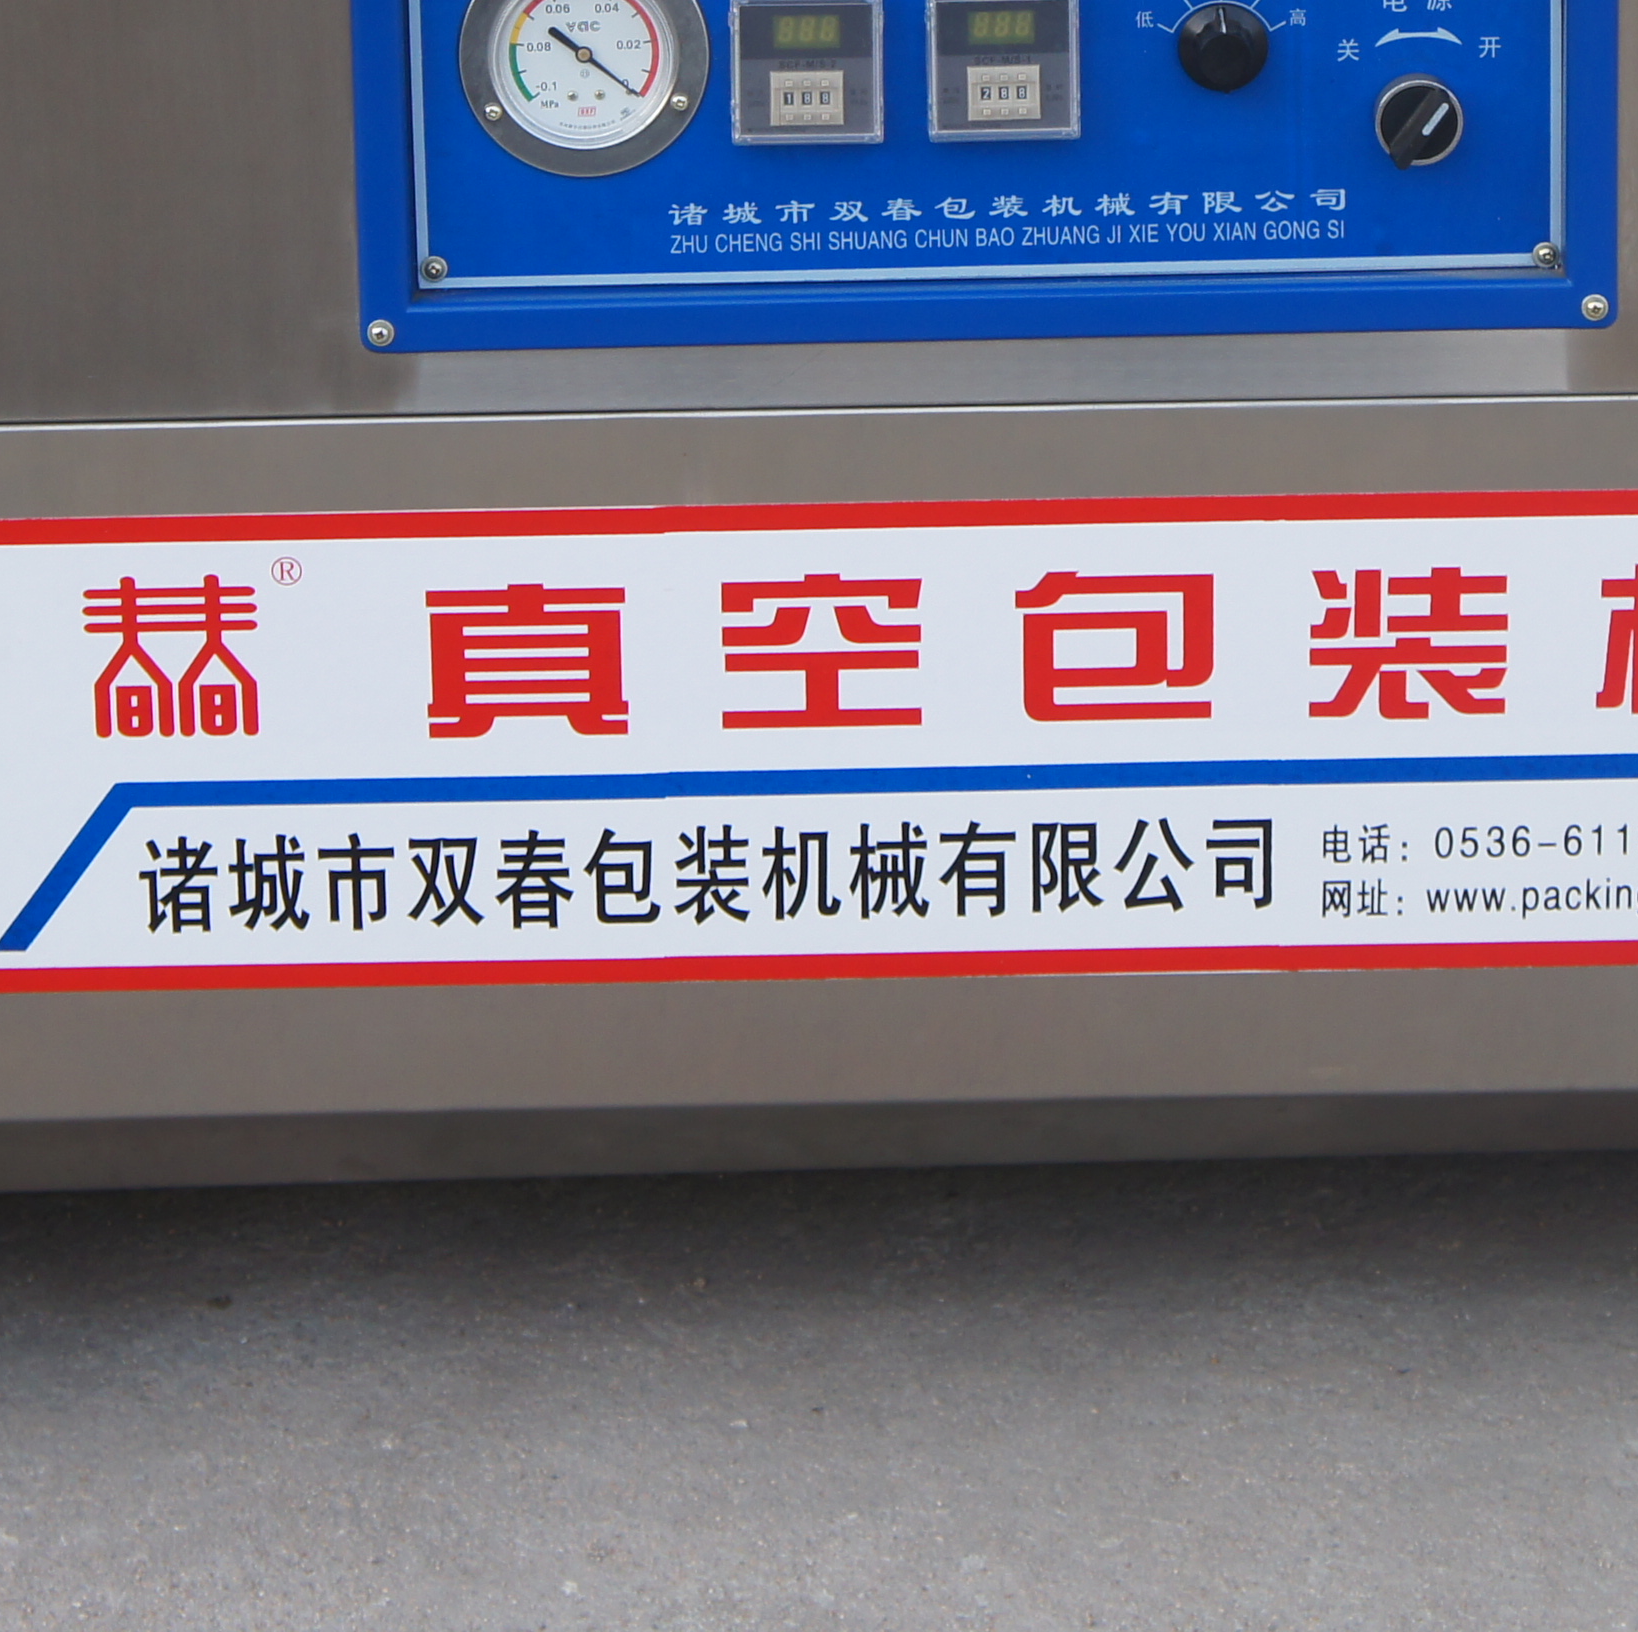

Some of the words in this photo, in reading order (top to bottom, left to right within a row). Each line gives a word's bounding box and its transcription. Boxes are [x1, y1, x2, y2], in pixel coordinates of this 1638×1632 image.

[545, 3, 571, 14] 0.06
[594, 3, 620, 14] 0.04
[1290, 8, 1306, 26] 高
[1136, 11, 1154, 28] 低
[526, 42, 552, 52] 0.08
[616, 39, 642, 50] 0.02
[1337, 38, 1359, 62] 关
[1479, 36, 1501, 58] 开
[535, 81, 558, 91] -0.1
[540, 99, 560, 109] MPa
[668, 188, 1346, 227] 诸城市双春包装机械有限公司
[670, 233, 708, 254] ZHU
[715, 232, 783, 253] CHENG
[790, 232, 821, 251] SHI
[828, 229, 907, 250] SHUANG
[915, 228, 969, 248] CHUN
[975, 226, 1015, 247] BAO
[1021, 225, 1100, 246] ZHUANG
[1107, 225, 1121, 244] JI
[1129, 223, 1159, 243] XIE
[1166, 222, 1206, 242] YOU
[1213, 222, 1256, 241] XIAN
[1263, 220, 1320, 240] GONG
[1327, 219, 1344, 239] SI
[1322, 824, 1408, 863] 电话：
[138, 817, 1274, 934] 诸城市双春包装机械有限公司
[1322, 878, 1403, 918] 网址：
